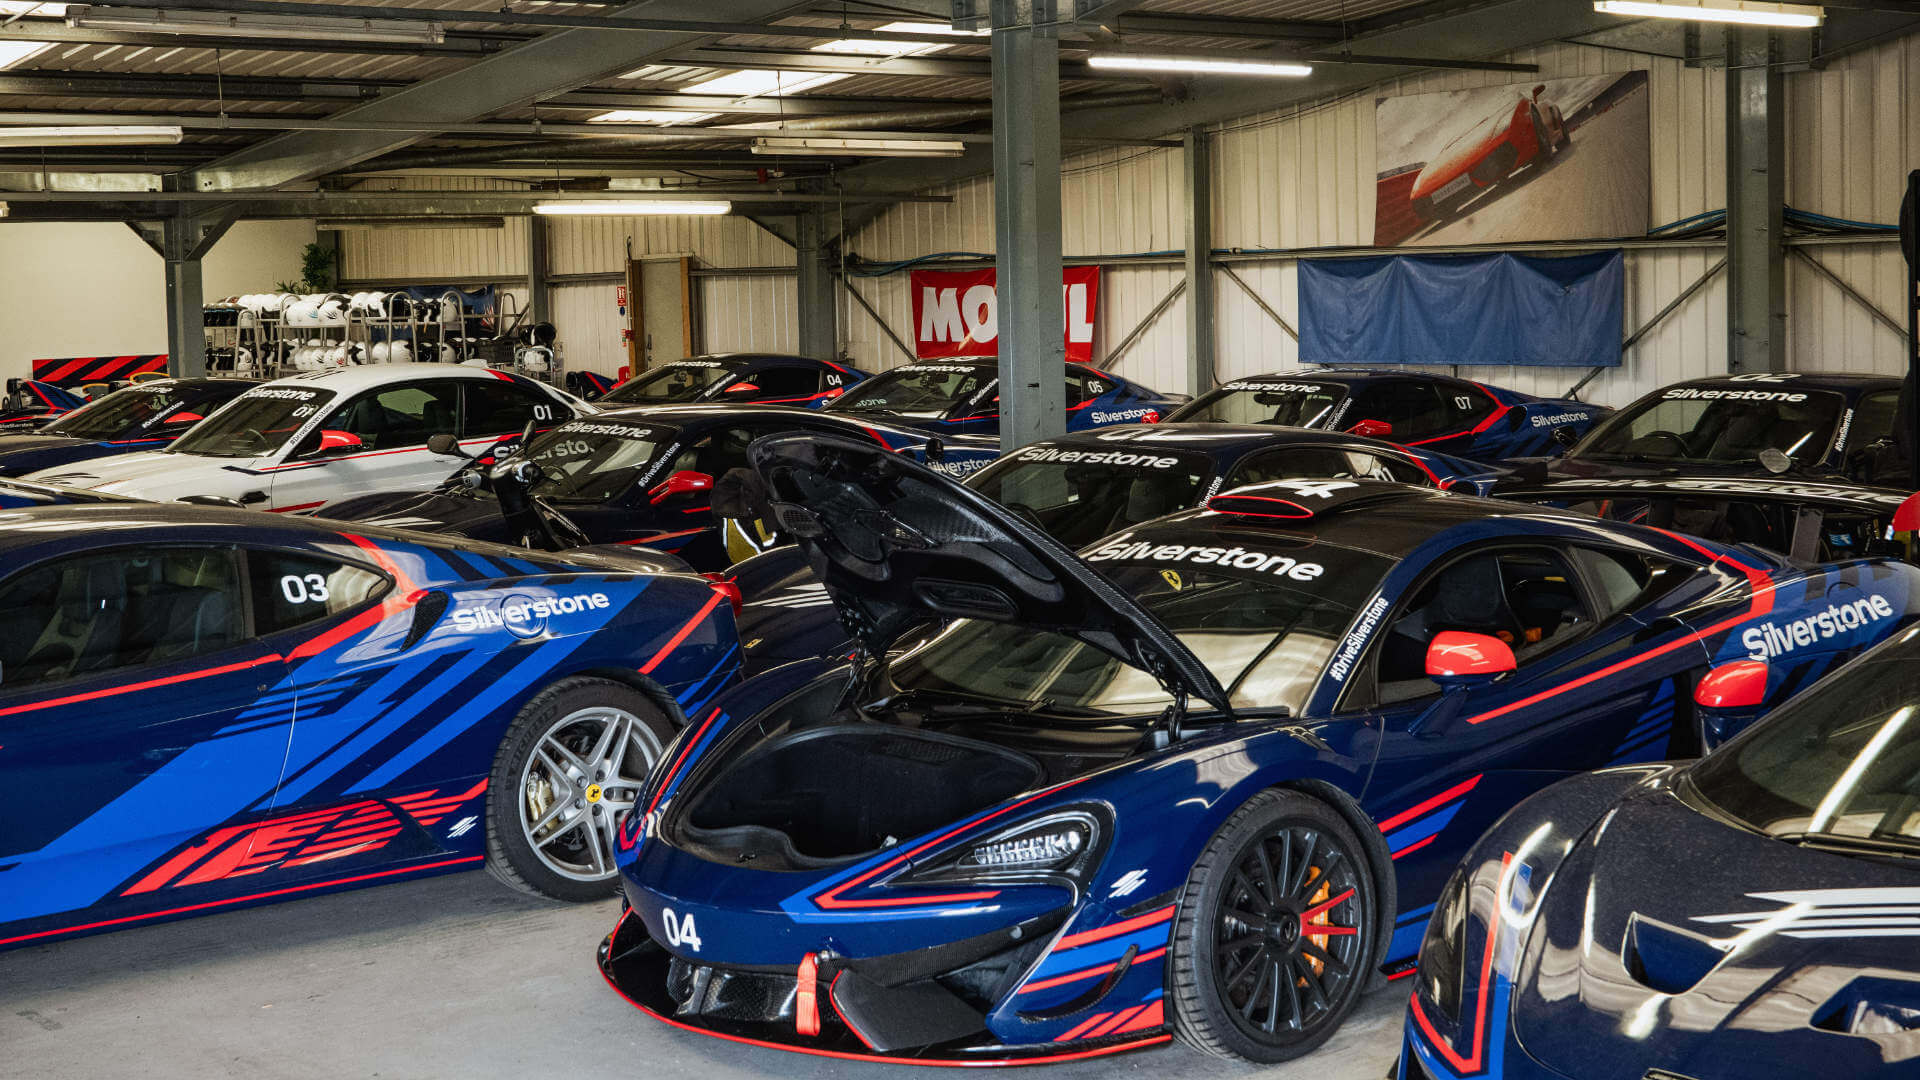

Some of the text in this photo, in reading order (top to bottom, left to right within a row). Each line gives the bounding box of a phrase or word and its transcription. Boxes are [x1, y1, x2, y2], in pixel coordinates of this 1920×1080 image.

[919, 283, 1094, 343] MOL
[826, 374, 842, 386] 04
[1222, 382, 1321, 393] Silverstone
[1454, 396, 1472, 410] 07
[1662, 388, 1808, 402] Silverstone
[533, 405, 553, 420] 01
[1530, 411, 1589, 428] Silverstone
[557, 421, 653, 438] Silverstone
[637, 441, 681, 488] #DriveSilverstone
[1018, 448, 1179, 469] Silverstone
[1087, 541, 1325, 582] Silverstone
[280, 573, 330, 604] 03
[453, 592, 611, 633] Silverstone
[1329, 596, 1390, 683] #DriveSilverstone
[1742, 593, 1894, 662] Silverstone
[662, 907, 702, 952] 04
